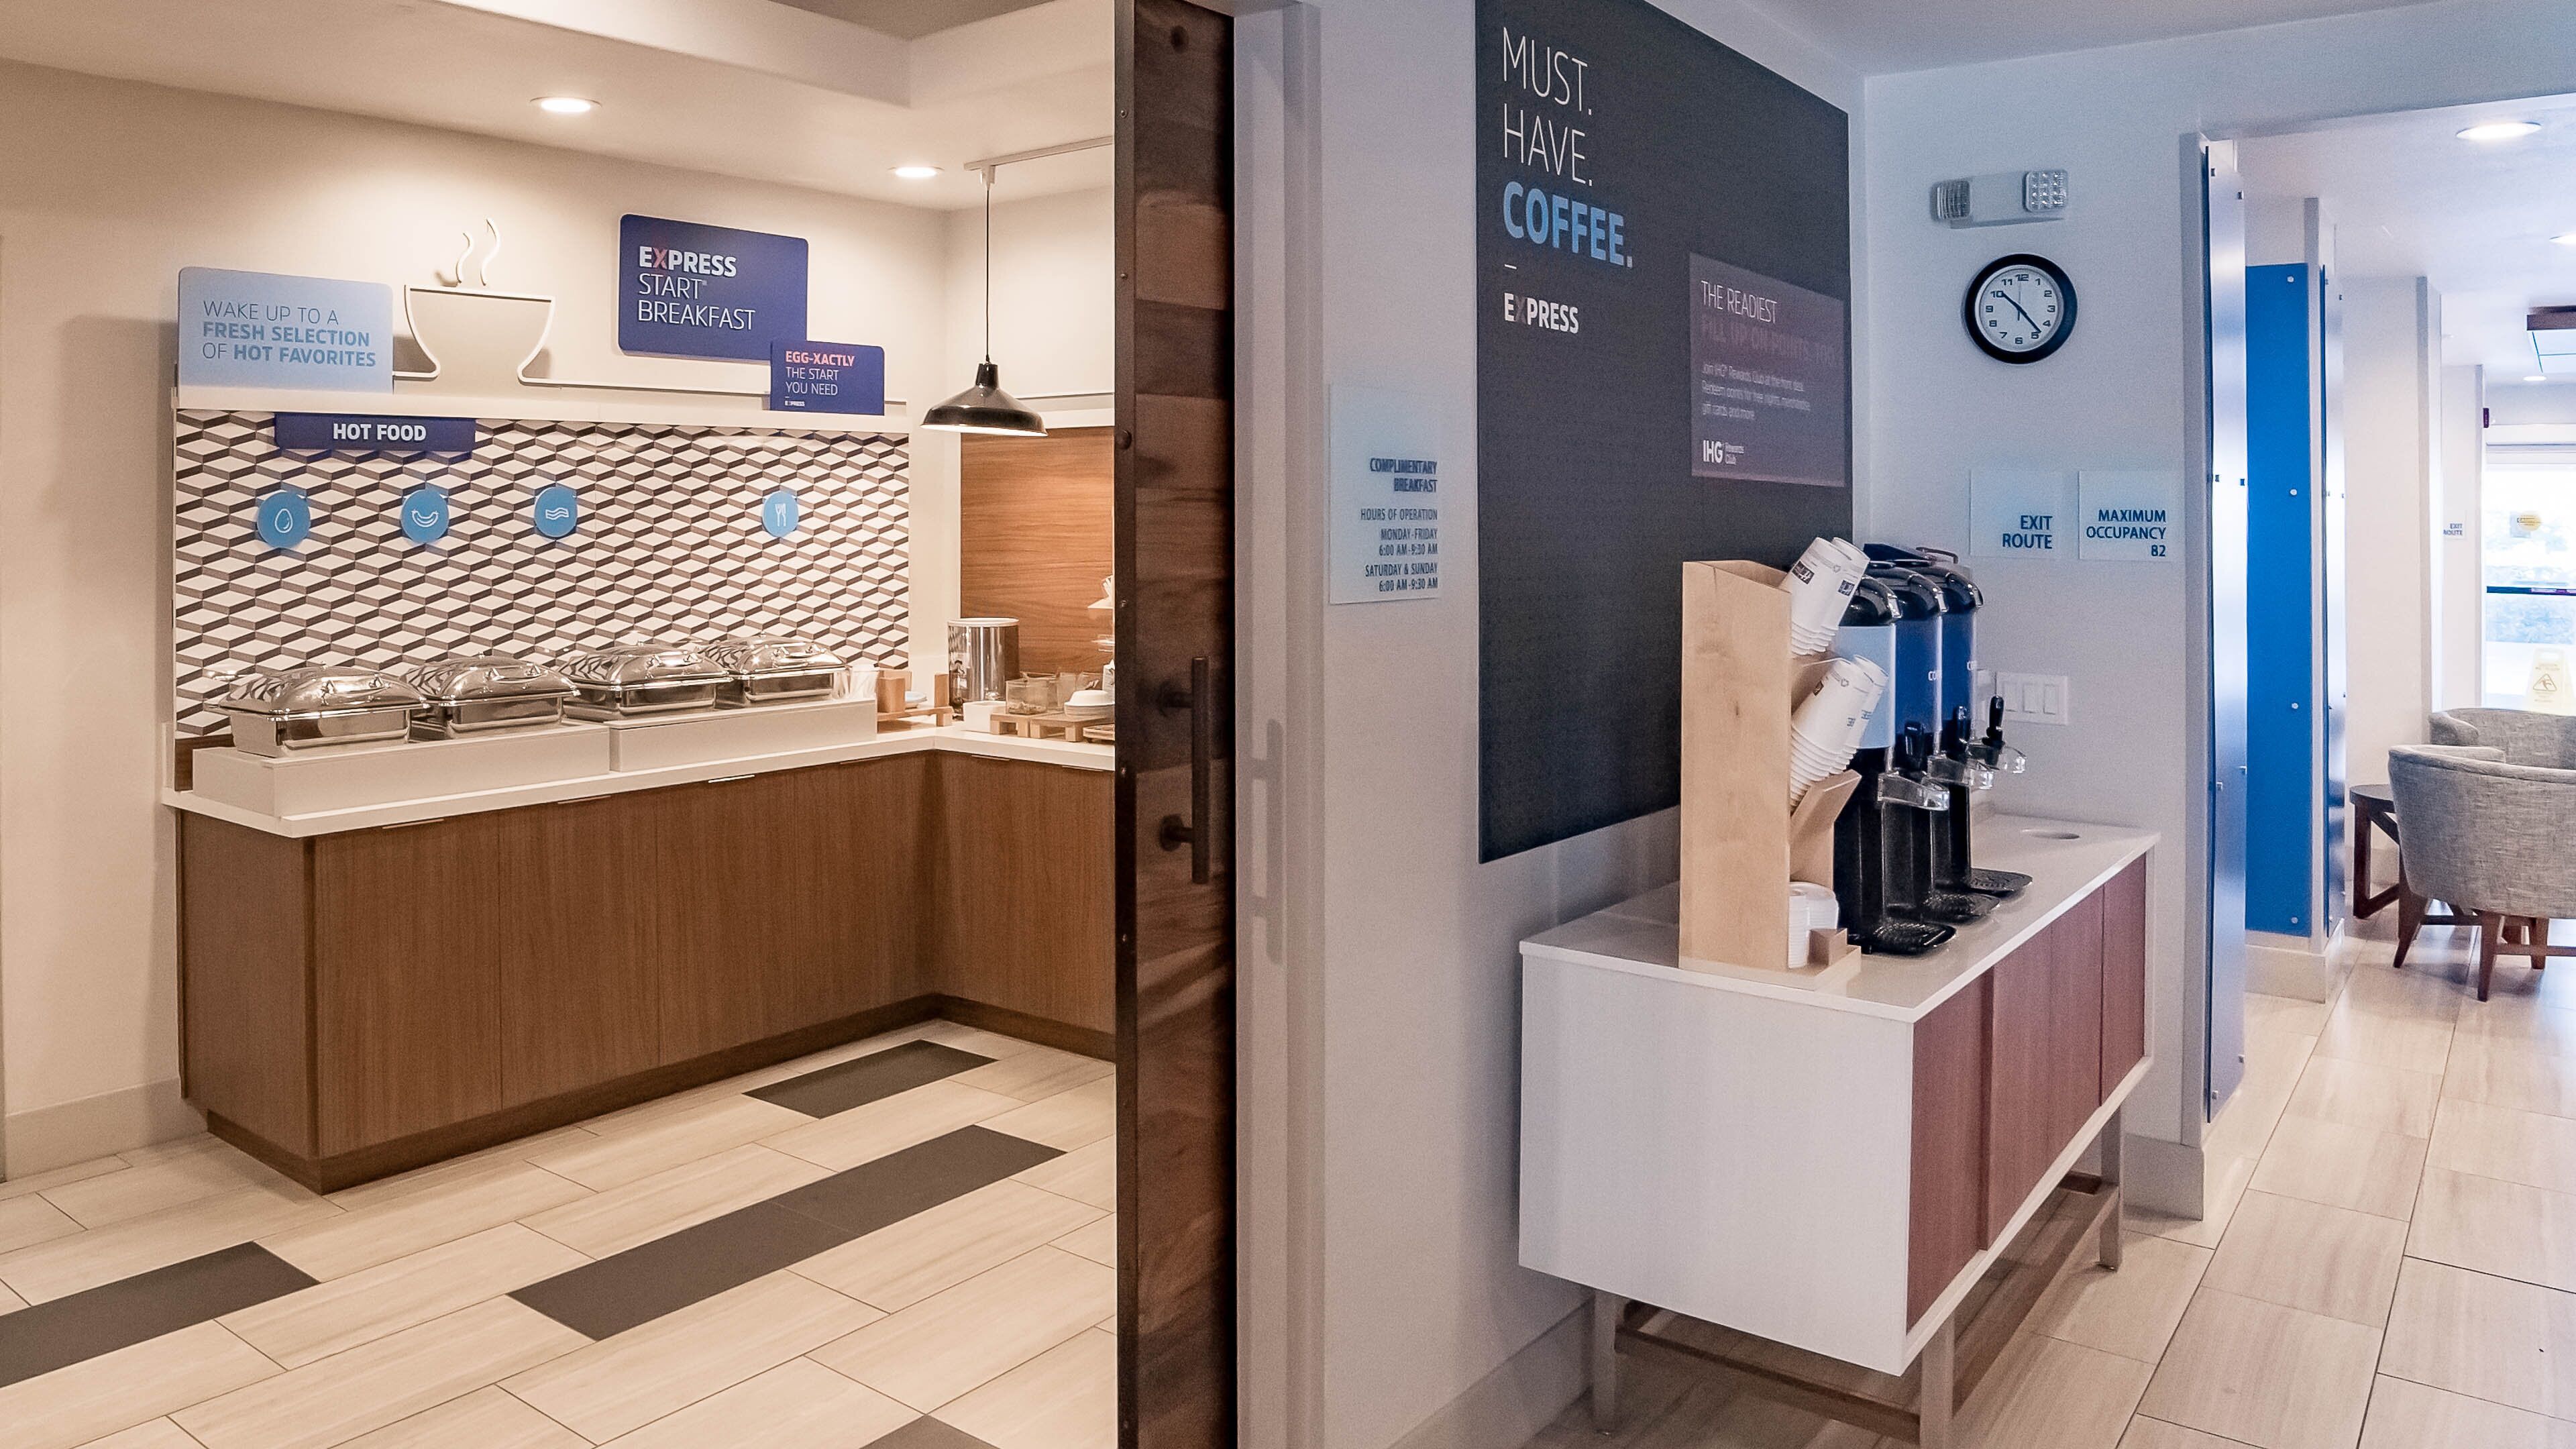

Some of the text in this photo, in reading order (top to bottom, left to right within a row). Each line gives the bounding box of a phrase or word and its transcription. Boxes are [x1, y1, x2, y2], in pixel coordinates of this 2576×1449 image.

[1503, 26, 1592, 115] MUST.
[1503, 102, 1593, 186] HAVE.
[1503, 180, 1633, 268] COFFEE.
[639, 246, 737, 278] EXPRESS
[1701, 280, 1778, 324] THE READIEST
[1990, 290, 2004, 298] 10
[203, 300, 339, 325] WAKE UP TO A
[637, 299, 756, 330] BREAKFAST
[1503, 292, 1580, 334] EXPRESS
[203, 321, 370, 347] FRESH SELECTION
[2015, 337, 2023, 345] 6
[202, 342, 376, 368] OF HOT FAVORITES
[785, 351, 855, 367] EGG-XACTLY
[785, 366, 840, 381] THE START
[785, 381, 838, 396] YOU NEED
[333, 423, 427, 441] HOT FOOD
[1703, 439, 1723, 464] IHG
[1370, 458, 1438, 475] COMPLIMENTARY
[1394, 477, 1438, 493] BREAKFAST
[1360, 508, 1438, 521] HOURS OF OPERATION
[2020, 515, 2053, 530] EXIT
[2098, 508, 2167, 523] MAXIMUM
[2086, 526, 2167, 539] OCCUPANCY
[1427, 543, 1438, 555] AM
[2002, 533, 2053, 549] ROUTE
[2151, 544, 2167, 557] 82
[1364, 562, 1438, 577] SATURDAY & SUNDAY
[1379, 579, 1395, 592] 6:00
[1427, 577, 1438, 589] AM
